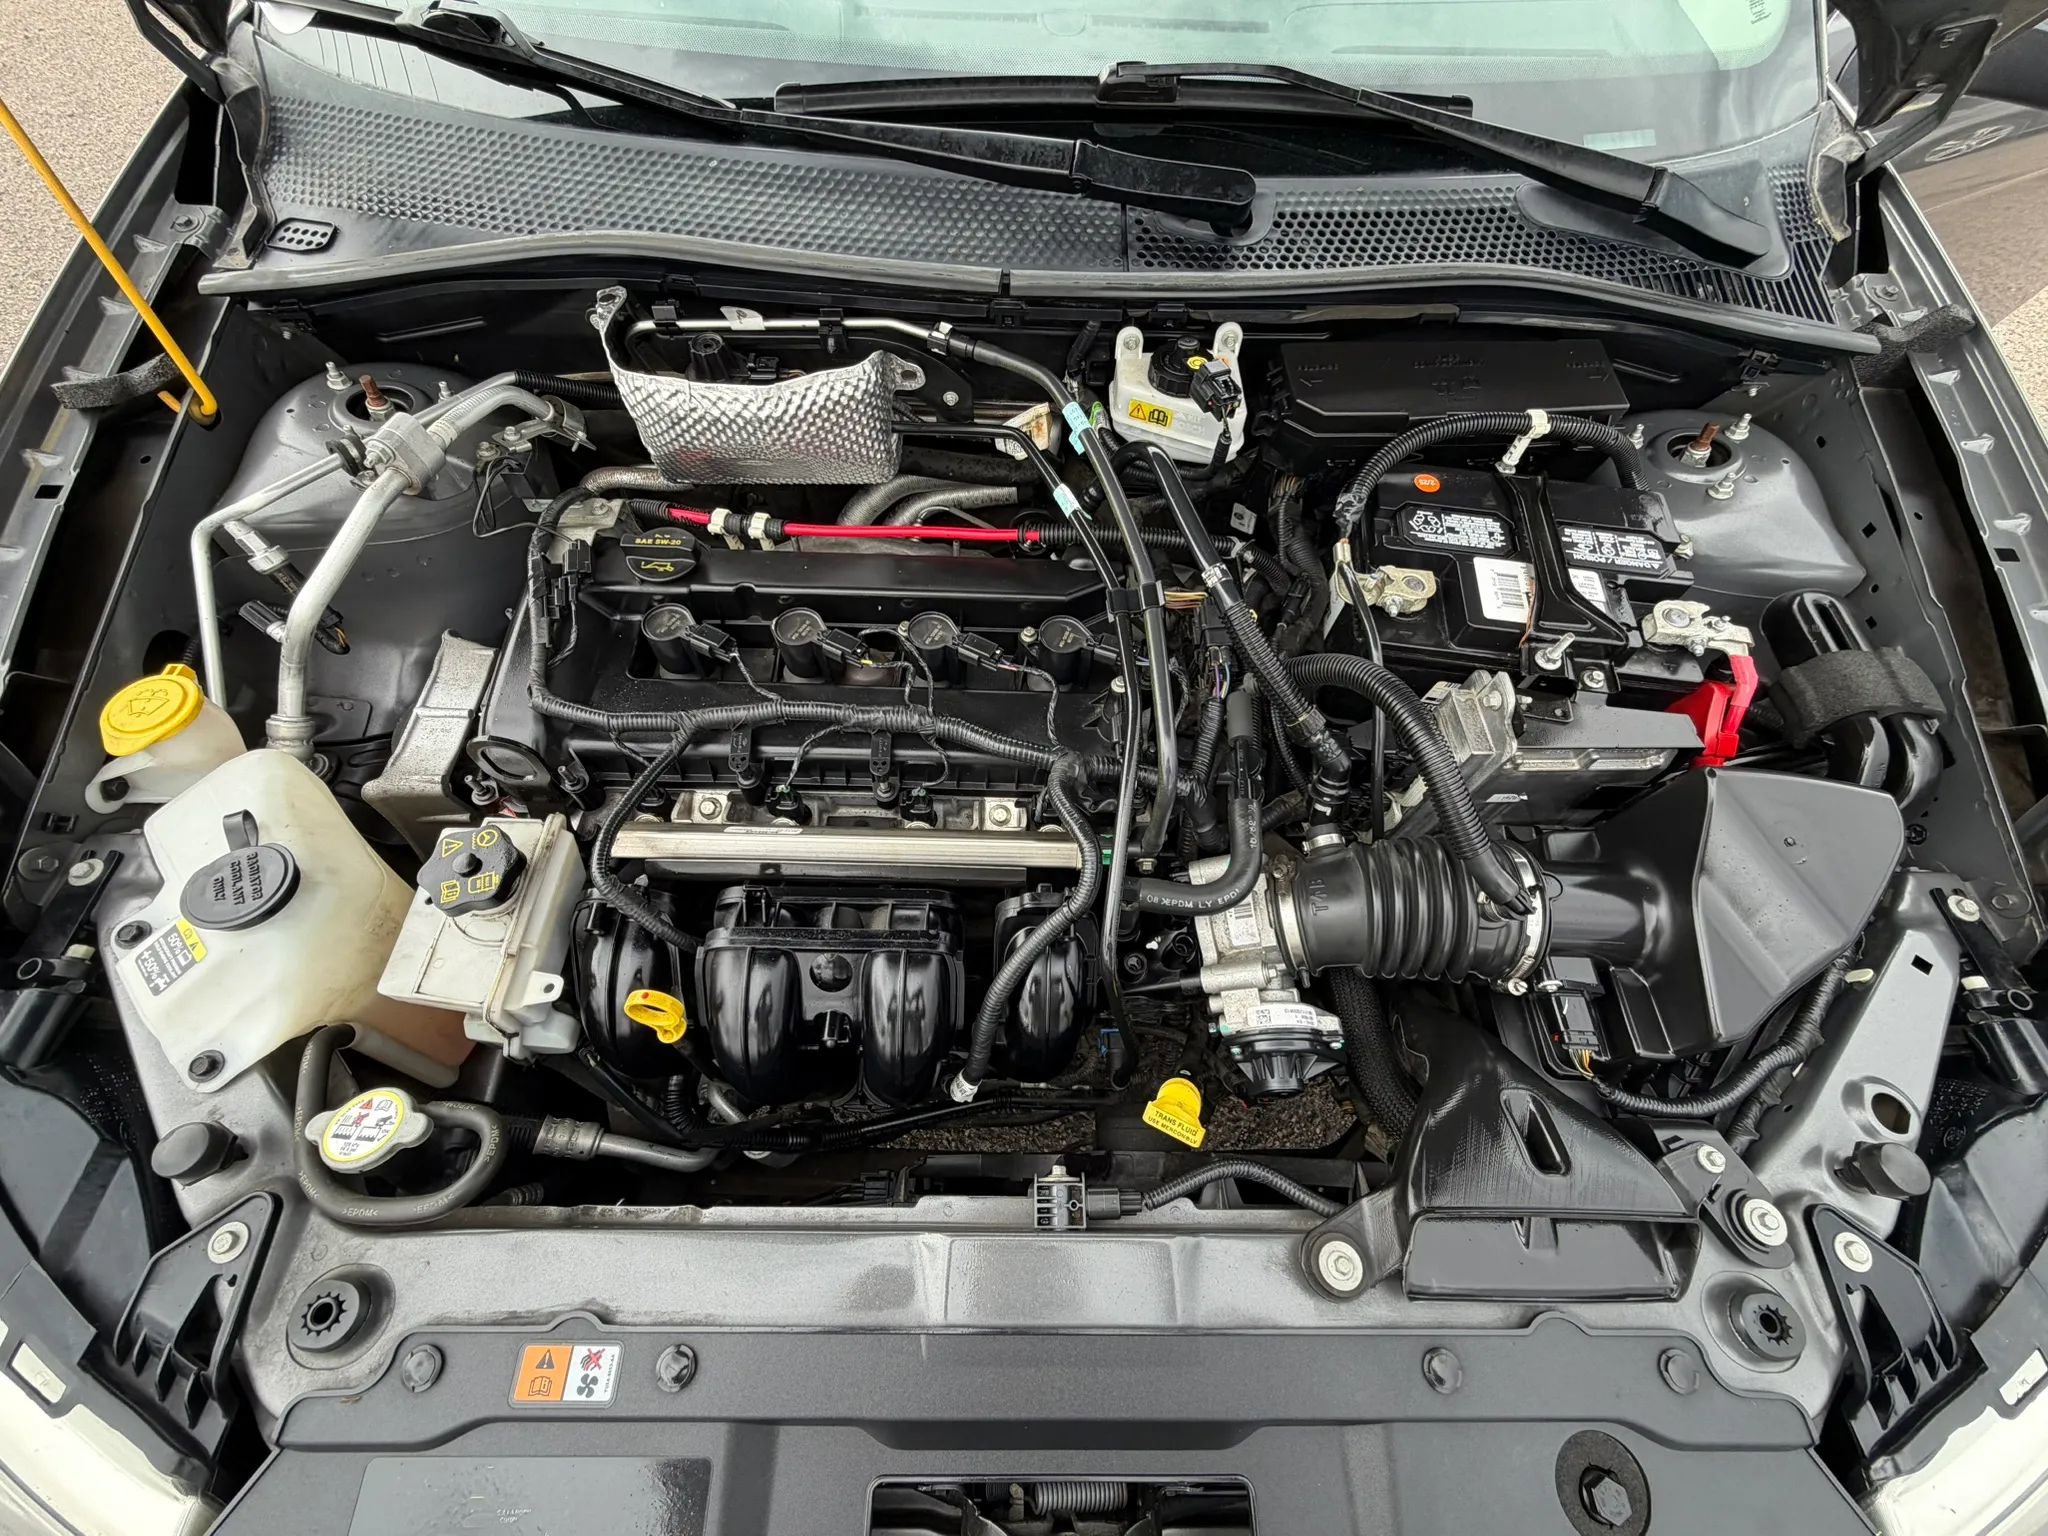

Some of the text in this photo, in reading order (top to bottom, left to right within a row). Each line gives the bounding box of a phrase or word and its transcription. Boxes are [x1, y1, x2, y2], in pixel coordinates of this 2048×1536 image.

[654, 538, 682, 546] 5W-20
[1573, 554, 1606, 563] POISON
[1615, 558, 1650, 568] DANGER
[229, 859, 246, 906] COOLANT
[246, 851, 264, 901] RADIATOR
[212, 875, 228, 902] ONLY
[1198, 900, 1213, 909] LY
[167, 932, 184, 955] 50%
[1148, 1116, 1159, 1126] USE
[1155, 1111, 1198, 1137] TRANS FLUID
